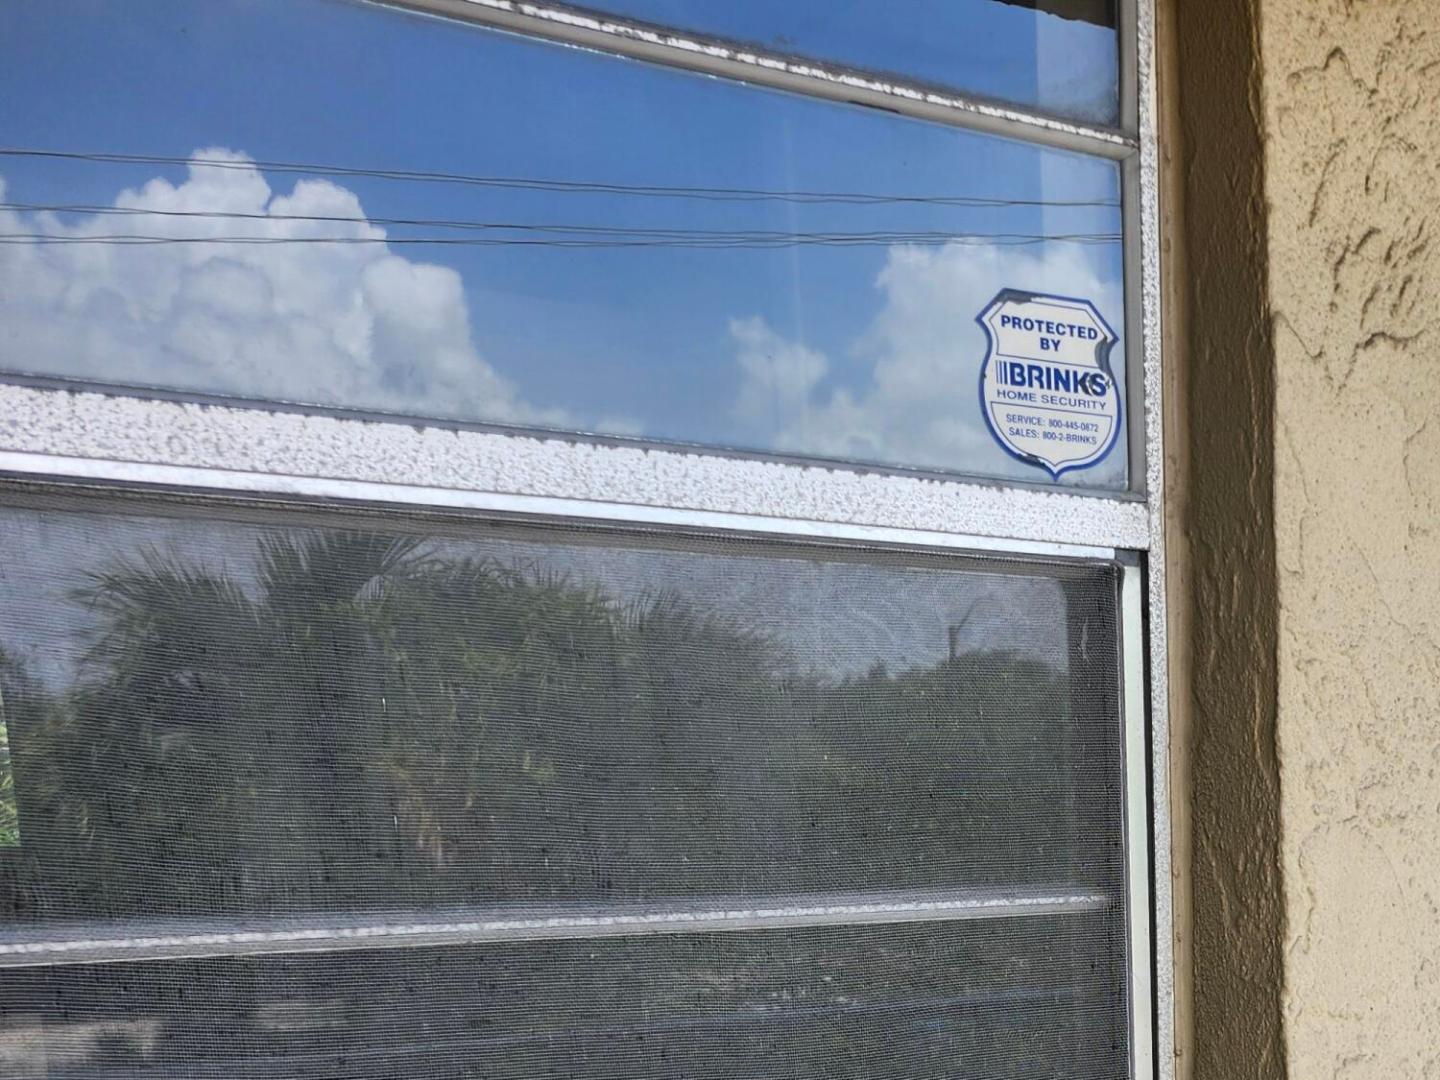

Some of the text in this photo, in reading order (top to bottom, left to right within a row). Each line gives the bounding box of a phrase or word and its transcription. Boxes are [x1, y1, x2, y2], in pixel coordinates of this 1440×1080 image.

[1001, 315, 1098, 340] PROTECTED
[1040, 339, 1061, 351] BY
[1009, 362, 1107, 397] BRINKS
[997, 389, 1106, 410] HOME SECURITY
[1006, 413, 1046, 427] SERVICE:
[1009, 427, 1040, 439] SALES:
